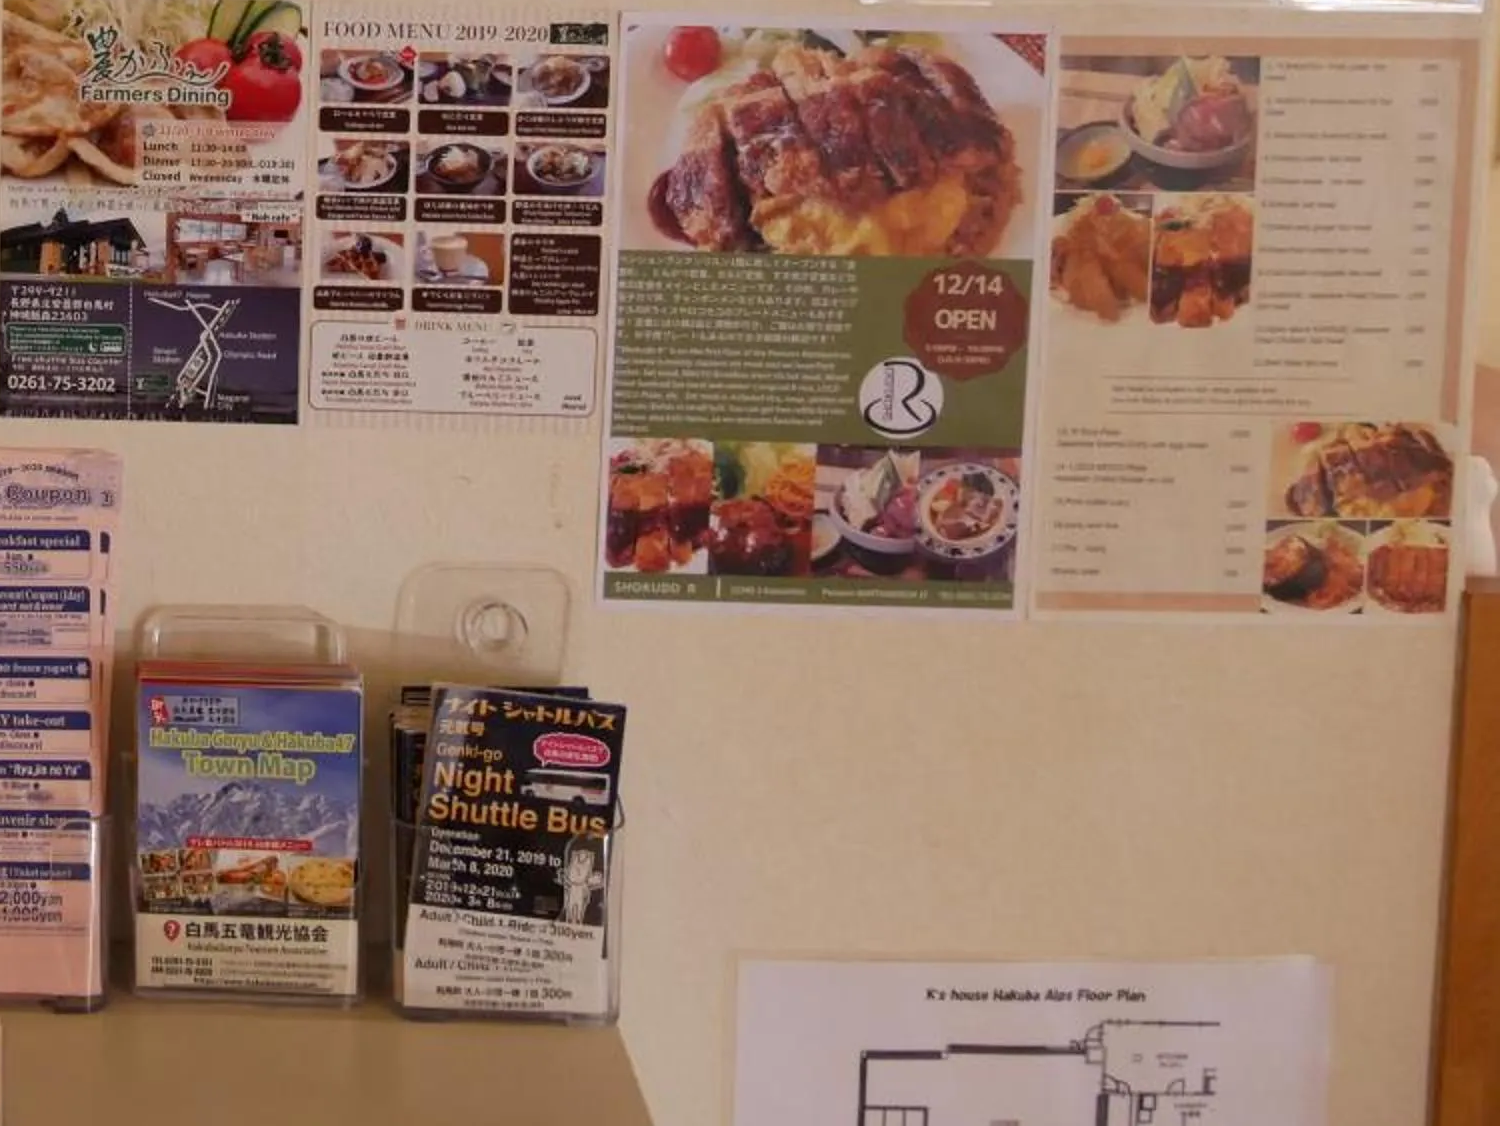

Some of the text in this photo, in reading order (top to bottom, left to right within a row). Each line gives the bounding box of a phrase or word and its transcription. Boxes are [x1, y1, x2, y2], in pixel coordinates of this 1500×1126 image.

[323, 22, 548, 42] FOOD MENU 2019 2020
[81, 86, 229, 106] Farmers Dining
[143, 141, 178, 153] Lunch
[143, 156, 180, 167] Dinner
[142, 170, 181, 182] Closed
[933, 274, 1003, 296] 12/14
[935, 309, 996, 330] OPEN
[7, 376, 116, 392] 0261-75-3202
[436, 743, 503, 762] Genki-go
[181, 750, 315, 785] Town Map
[433, 762, 515, 797] Night
[428, 793, 607, 839] Shuttle Bus
[485, 863, 513, 877] 2020
[549, 855, 561, 867] to
[949, 988, 989, 1002] house
[993, 989, 1040, 1002] Hakuba
[1078, 988, 1114, 1002] Floor
[1117, 989, 1146, 1003] Plan
